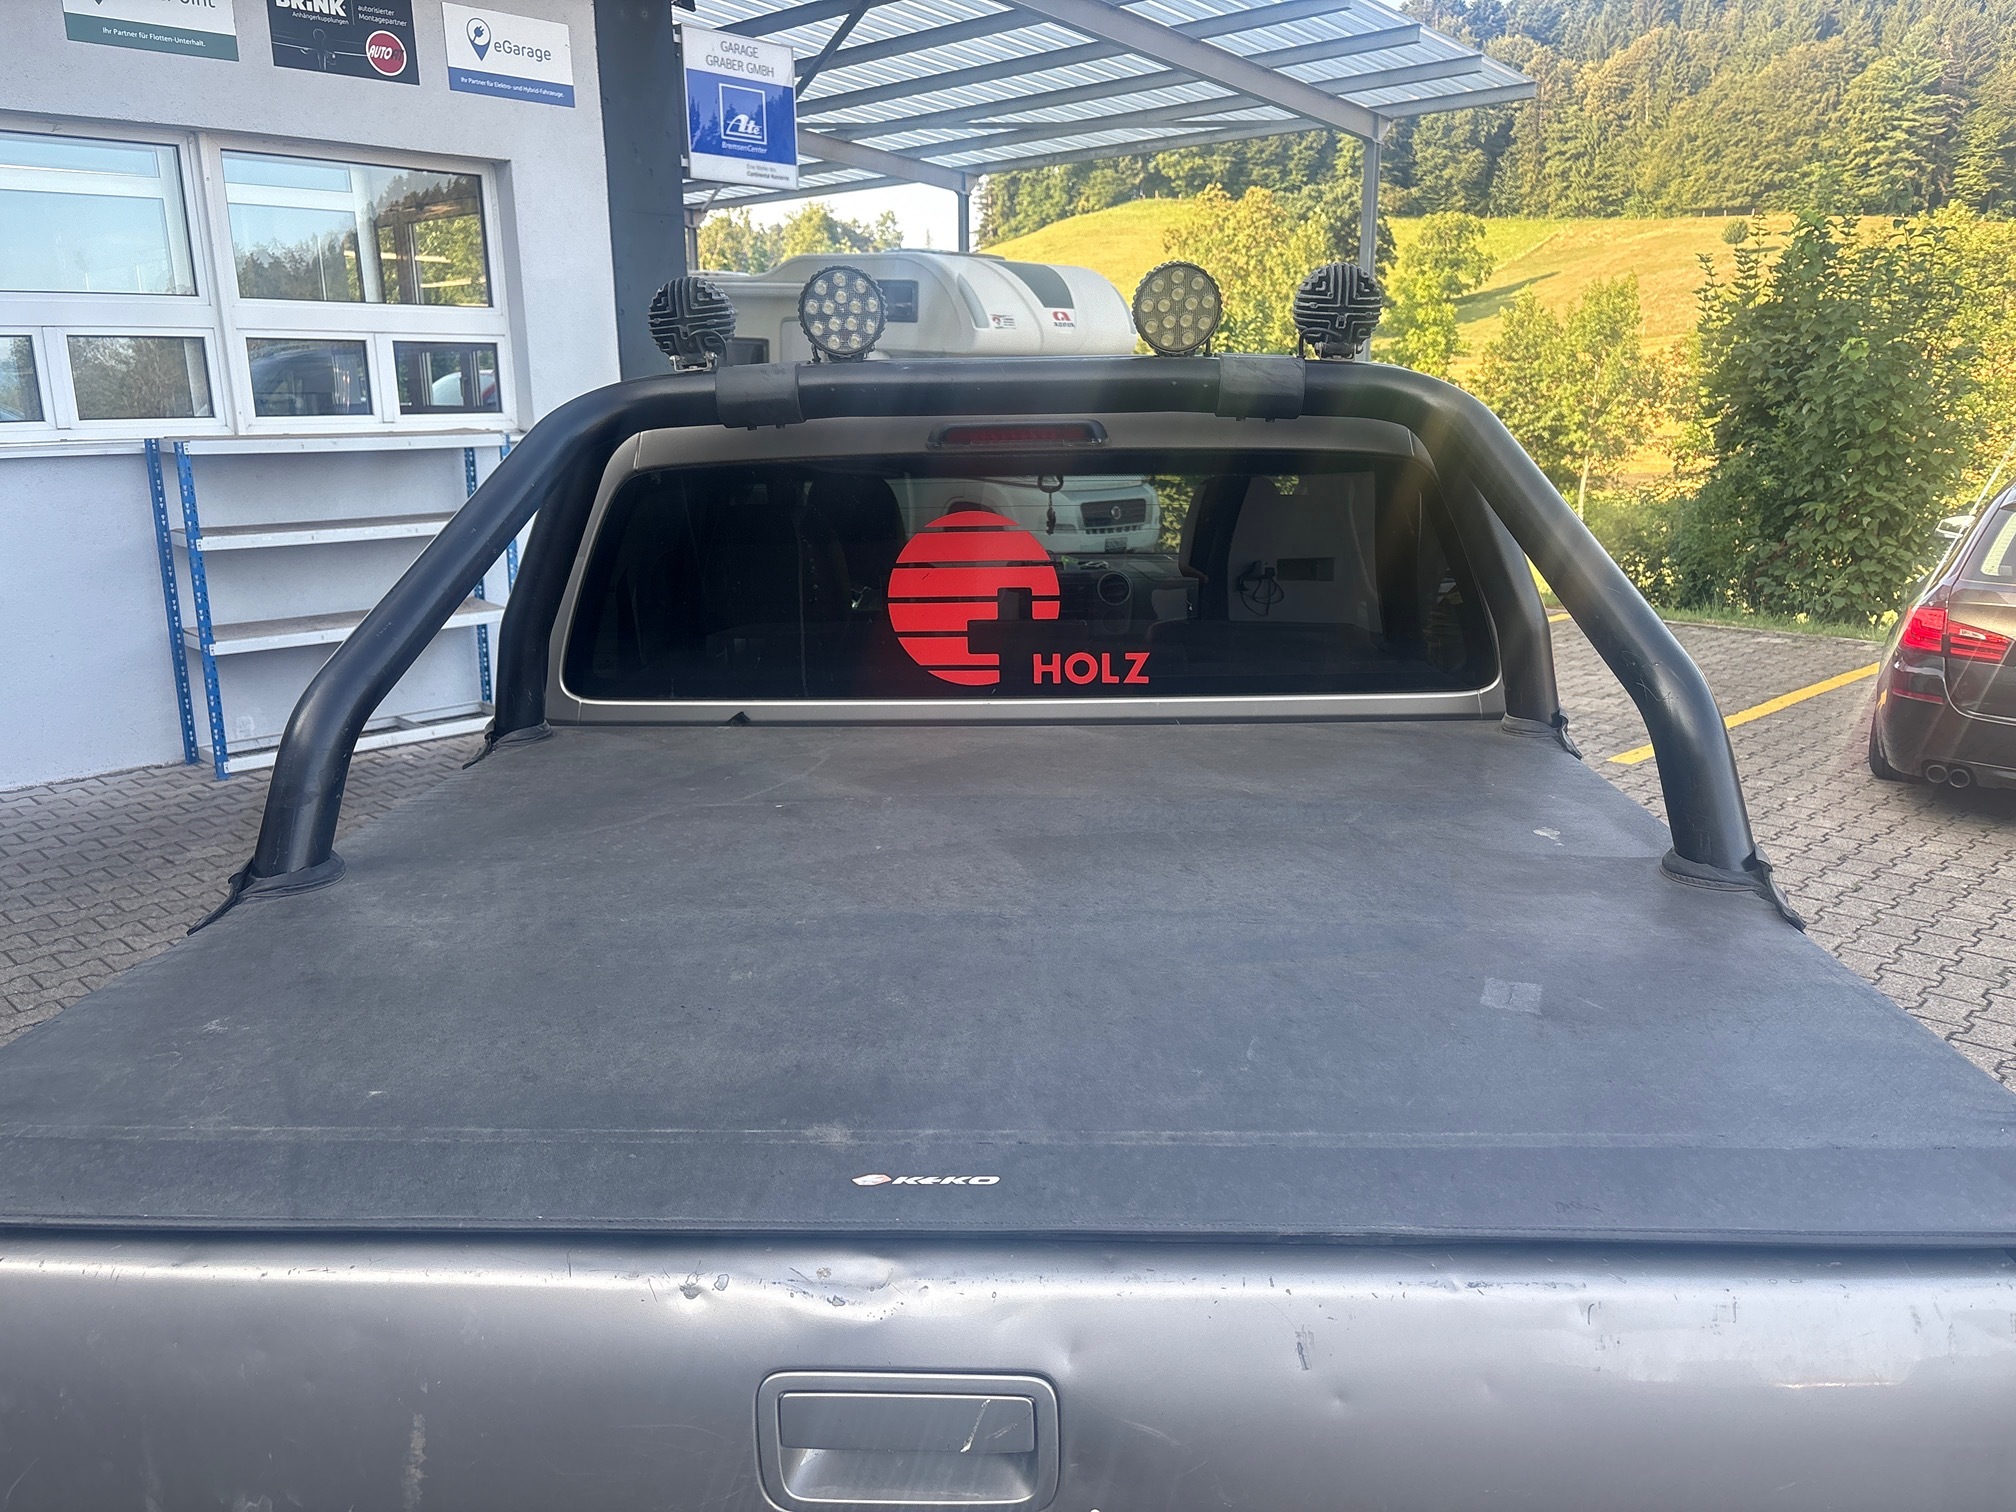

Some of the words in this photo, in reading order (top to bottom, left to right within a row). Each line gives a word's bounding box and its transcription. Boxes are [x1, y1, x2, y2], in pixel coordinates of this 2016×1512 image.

[292, 11, 349, 25] Anhängerkupplungen
[357, 5, 395, 16] autorisierter
[358, 13, 408, 27] Montagepartner
[102, 27, 112, 35] Ihr
[113, 28, 137, 38] Partner
[138, 31, 148, 39] für
[149, 33, 206, 47] Flotten-Unterhalt.
[494, 40, 552, 62] eGarage
[720, 40, 759, 58] GARAGE
[705, 54, 744, 72] GRABER
[745, 62, 774, 78] GMBH
[1033, 651, 1150, 685] HOLZ
